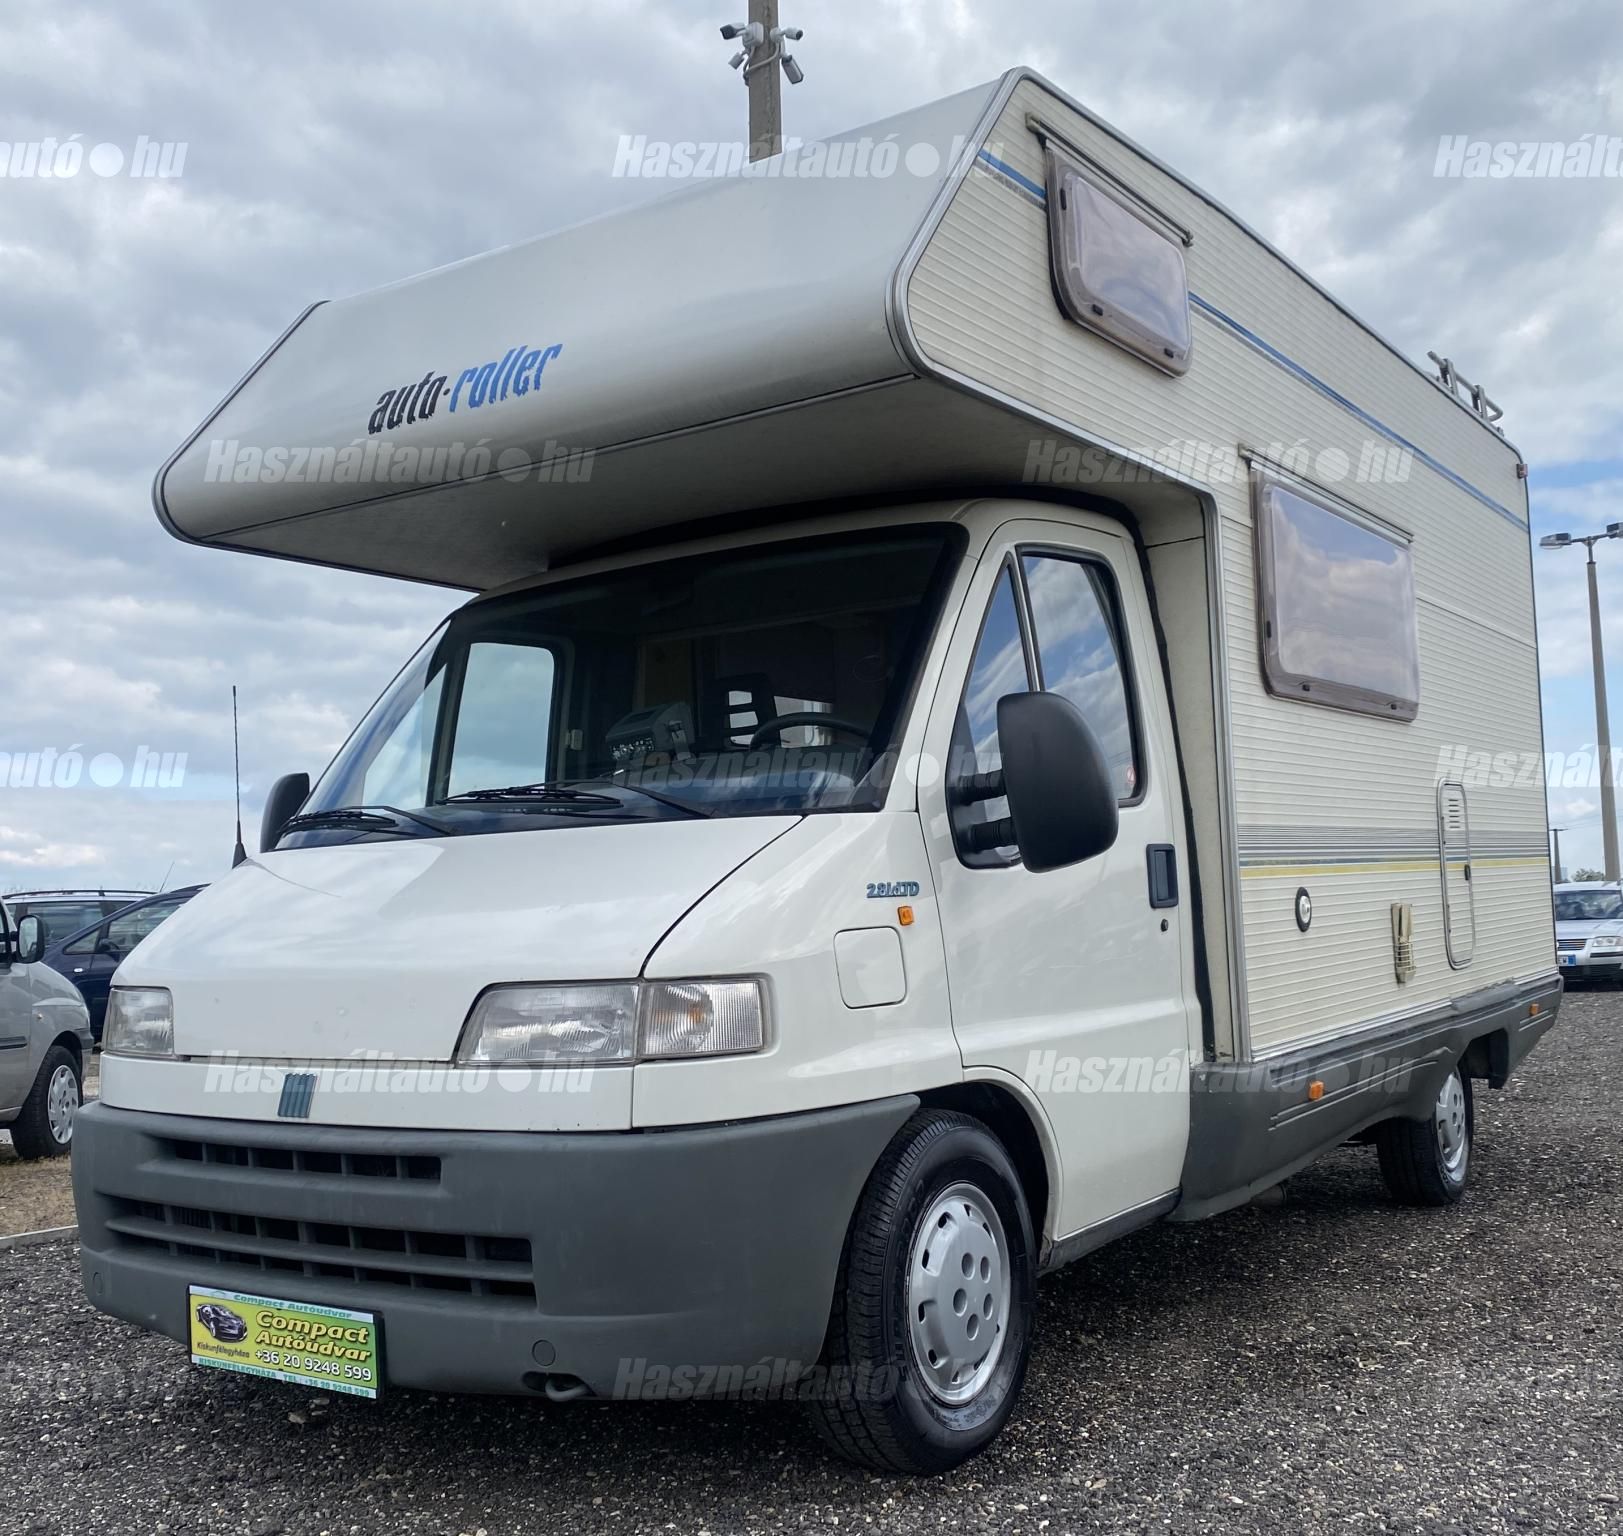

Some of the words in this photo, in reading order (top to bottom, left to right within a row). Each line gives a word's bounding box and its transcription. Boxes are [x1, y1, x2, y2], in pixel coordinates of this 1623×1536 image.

[233, 1294, 285, 1309] Compact
[287, 1302, 352, 1318] Autóudvar
[256, 1310, 369, 1344] Compact
[256, 1331, 371, 1361] Autóudvar
[255, 1350, 280, 1365] +36
[283, 1353, 301, 1368] 20
[304, 1357, 340, 1376] 9248
[344, 1364, 372, 1381] 599
